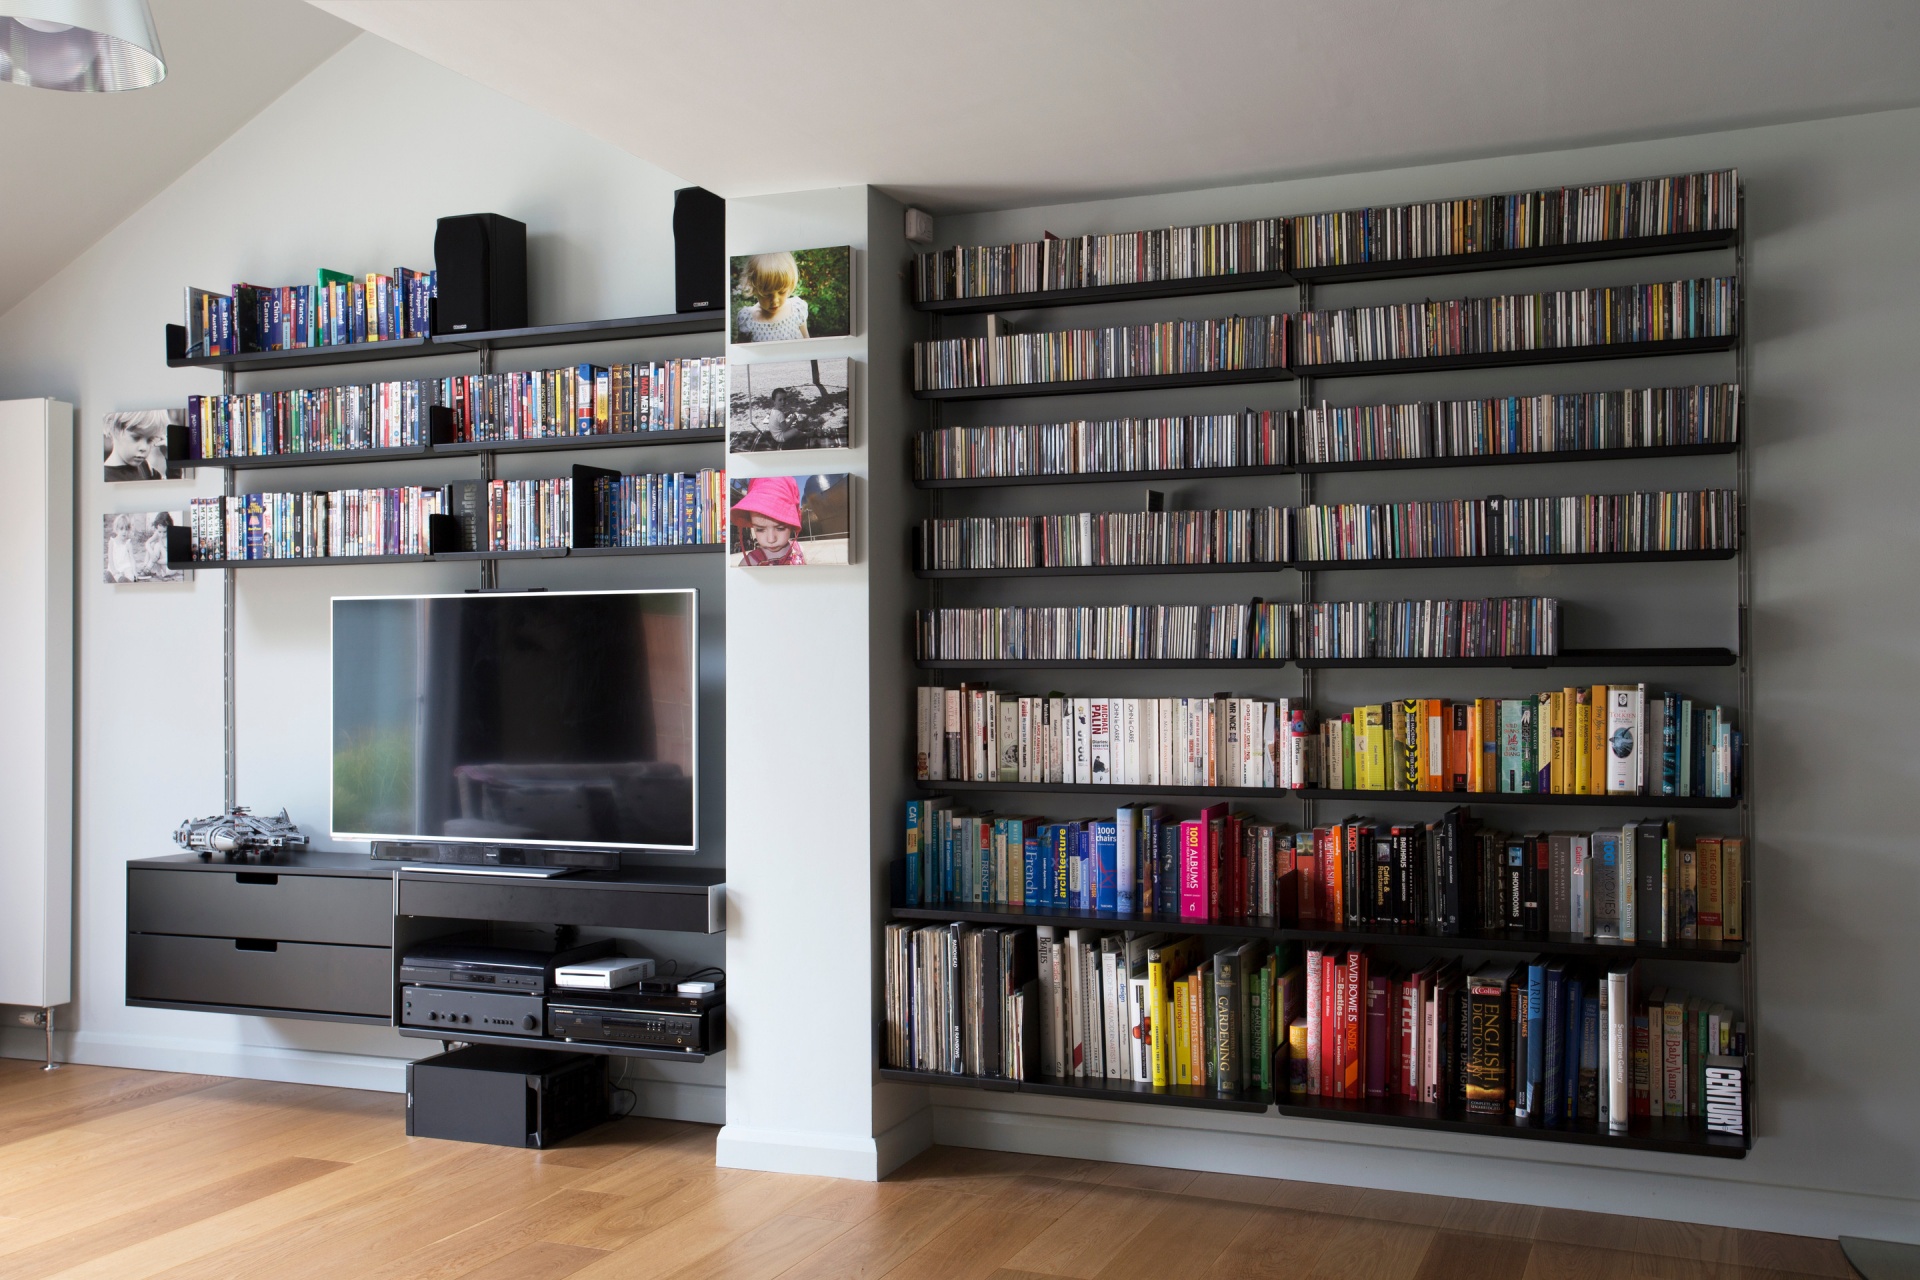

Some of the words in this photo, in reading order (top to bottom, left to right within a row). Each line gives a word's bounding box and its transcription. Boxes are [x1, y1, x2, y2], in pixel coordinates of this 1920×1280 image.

[640, 377, 649, 396] MAD
[640, 395, 649, 414] MEN
[1092, 704, 1101, 735] PALIN
[909, 806, 917, 823] CAT
[1190, 826, 1198, 847] 1001
[1326, 837, 1334, 864] EMPIRE
[1057, 828, 1067, 898] architecture
[1604, 840, 1615, 866] 1001
[1025, 852, 1038, 894] French
[1190, 849, 1198, 889] ALBUMS
[1326, 871, 1334, 886] SUN
[1604, 869, 1615, 915] MOVIES
[1038, 937, 1050, 964] BEATLES
[1107, 978, 1113, 986] OF
[1348, 954, 1358, 983] DAVID
[1336, 983, 1345, 1016] Beatles
[1348, 983, 1358, 1012] BOWIE
[1530, 980, 1540, 1013] ARUP
[1402, 995, 1412, 1037] PEEL
[1460, 997, 1468, 1048] JAPANESE
[1218, 996, 1229, 1071] GARDENING
[1348, 1023, 1358, 1050] INSIDE
[1472, 1003, 1483, 1080] DICTIONARY
[1484, 1004, 1499, 1081] ENGLISH
[1616, 1024, 1624, 1059] Serpentine
[1636, 1025, 1648, 1053] ZADIE
[1665, 1040, 1681, 1066] Baby
[1460, 1053, 1468, 1092] DESIGN
[1616, 1060, 1624, 1083] Gallery
[1636, 1057, 1648, 1085] SMITH
[1665, 1066, 1681, 1099] Names
[1705, 1068, 1743, 1135] CENTURY
